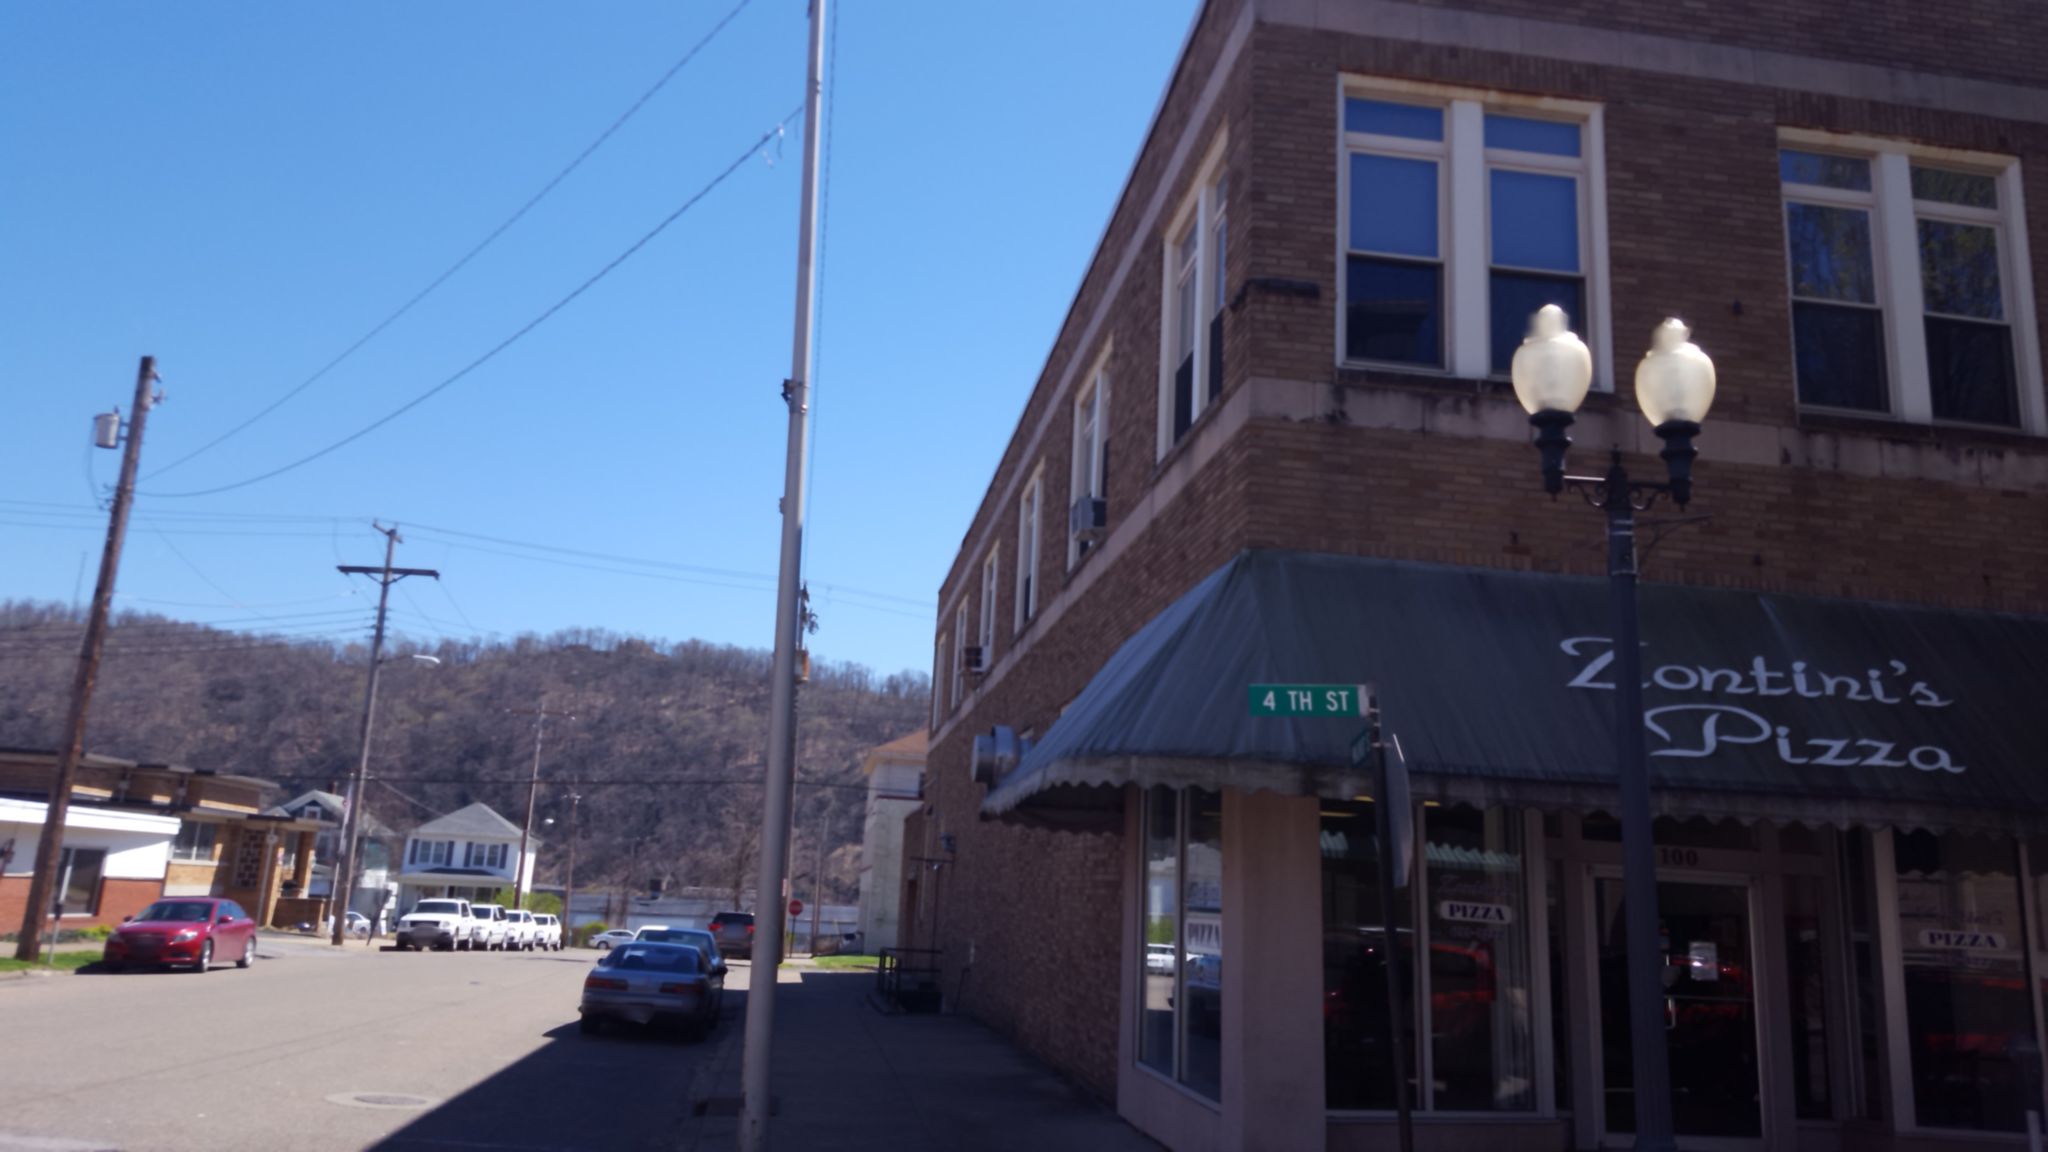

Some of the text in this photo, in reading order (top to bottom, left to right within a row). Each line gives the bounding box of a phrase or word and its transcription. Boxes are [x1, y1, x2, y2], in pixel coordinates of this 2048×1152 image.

[1560, 636, 1953, 706] Zontini's
[1262, 690, 1350, 711] 4 TH ST
[1644, 704, 1966, 773] Pizza
[1660, 848, 1699, 866] 100
[1448, 903, 1506, 921] PIZZA
[1188, 923, 1220, 948] PIZZA
[1928, 932, 1998, 948] PIZZA
